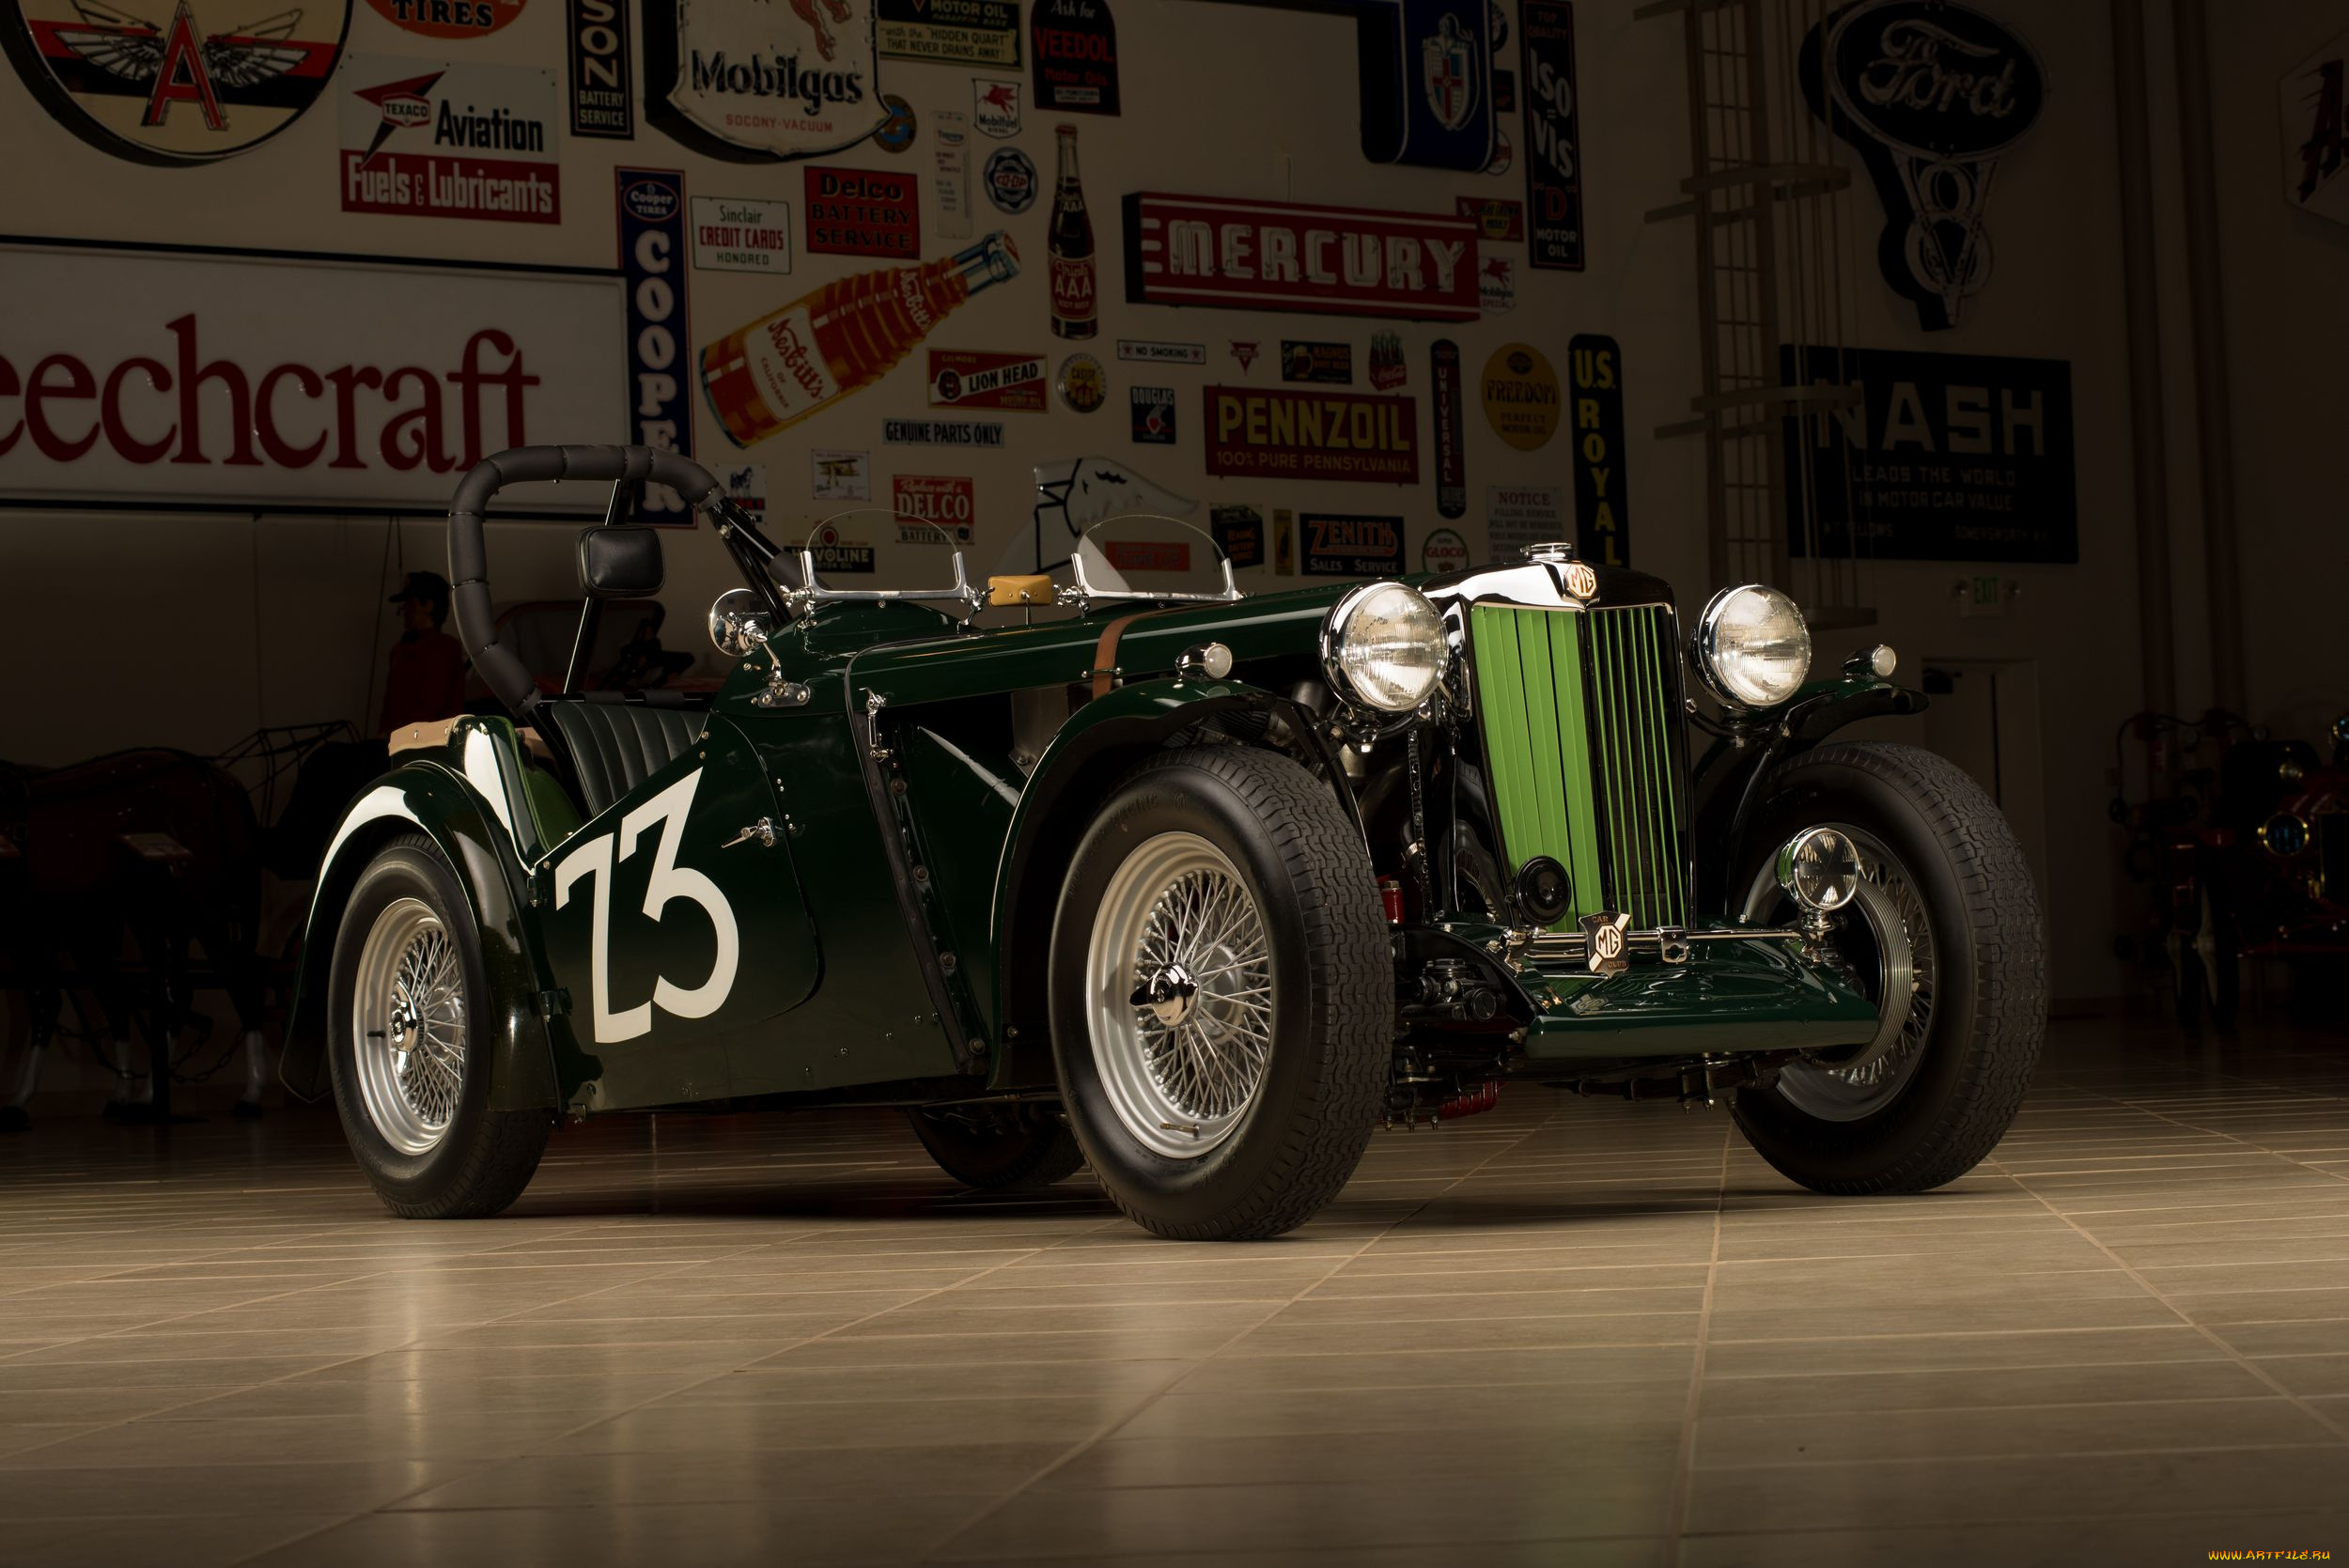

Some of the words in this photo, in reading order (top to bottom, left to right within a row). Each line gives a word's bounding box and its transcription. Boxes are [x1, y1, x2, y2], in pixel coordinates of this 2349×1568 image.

[393, 0, 493, 26] TIRES
[930, 0, 980, 15] MOTOR
[984, 4, 1008, 18] OIL
[1050, 0, 1076, 17] Ask
[1080, 1, 1097, 19] for
[887, 39, 907, 50] THAT
[910, 40, 939, 54] NEVER
[942, 44, 973, 57] DRAINS
[1034, 26, 1114, 62] VEEDOL
[1859, 18, 2016, 117] Ford
[692, 50, 863, 116] Mobilgas
[385, 102, 428, 118] TEXACO
[579, 90, 624, 109] BATTERY
[435, 99, 543, 152] Aviation
[580, 109, 625, 127] SERVICE
[979, 113, 1017, 128] Mobilfuel
[348, 155, 411, 206] Fuels
[415, 173, 425, 207] &
[428, 160, 552, 214] Lubricants
[820, 174, 903, 200] Delco
[630, 191, 673, 206] Cooper
[636, 204, 668, 215] TIRES
[1544, 185, 1567, 221] D
[720, 205, 762, 225] Sinclair
[812, 202, 911, 225] BATTERY
[700, 225, 739, 248] CREDIT
[745, 229, 784, 250] CARDS
[814, 227, 913, 251] SERVICE
[1536, 228, 1577, 241] MOTOR
[717, 252, 770, 265] HONORED
[1168, 219, 1466, 293] MERCURY
[1548, 243, 1568, 257] OIL
[1054, 274, 1092, 299] AAA
[1136, 347, 1147, 356] NO
[1150, 347, 1188, 359] SMOKING
[634, 228, 687, 513] COOPER
[777, 371, 788, 383] OF
[969, 370, 998, 393] LION
[1003, 363, 1038, 384] HEAD
[760, 357, 789, 409] CALIFORNIA
[1487, 379, 1556, 406] FREEDOM
[1132, 388, 1174, 405] DOUGLAS
[1218, 395, 1410, 452] PENNZOIL
[1438, 368, 1453, 482] UNIVERSAL
[1813, 378, 2045, 457] NASH
[886, 422, 931, 442] GENUINE
[934, 424, 971, 443] PARTS
[974, 423, 1002, 444] ONLY
[1217, 451, 1254, 467] 100%
[1259, 453, 1298, 468] PURE
[1303, 454, 1410, 473] PENNSYLVANIA
[1578, 398, 1623, 567] ROYAL
[1852, 465, 1911, 482] LEADS
[1919, 466, 1951, 483] THE
[1960, 468, 2015, 487] WORLD
[896, 492, 970, 520] DELCO
[1499, 492, 1550, 505] NOTICE
[1859, 490, 1873, 507] IN
[1877, 490, 1928, 507] MOTOR
[1932, 492, 1964, 509] CAR
[1968, 493, 2014, 511] VALUE
[902, 531, 947, 543] BATTERY
[1308, 520, 1398, 556] ZENITH
[1310, 558, 1343, 572] SALES
[1354, 559, 1398, 573] SERVICE
[1573, 567, 1594, 593] MG
[1592, 915, 1609, 924] CAR
[1598, 929, 1619, 955] MG
